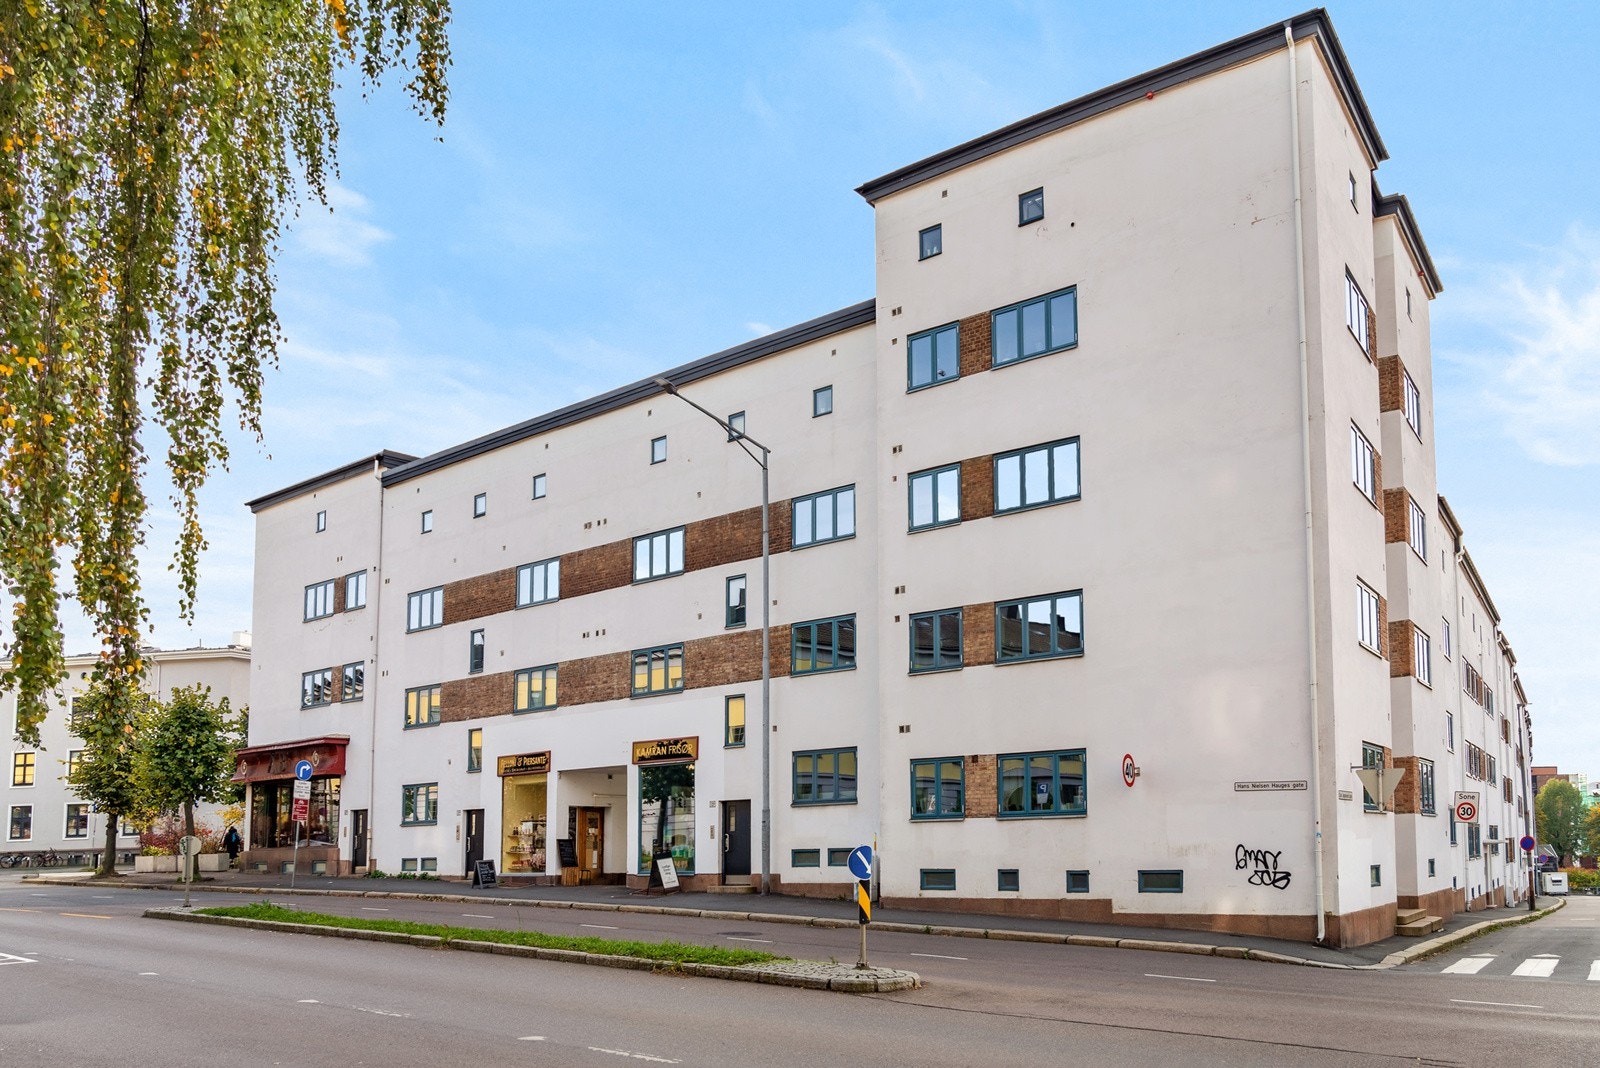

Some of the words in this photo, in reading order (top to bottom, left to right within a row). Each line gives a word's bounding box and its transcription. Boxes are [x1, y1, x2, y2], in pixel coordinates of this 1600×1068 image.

[668, 743, 693, 755] FRISØR
[1125, 762, 1134, 779] 40
[1460, 807, 1473, 816] 30
